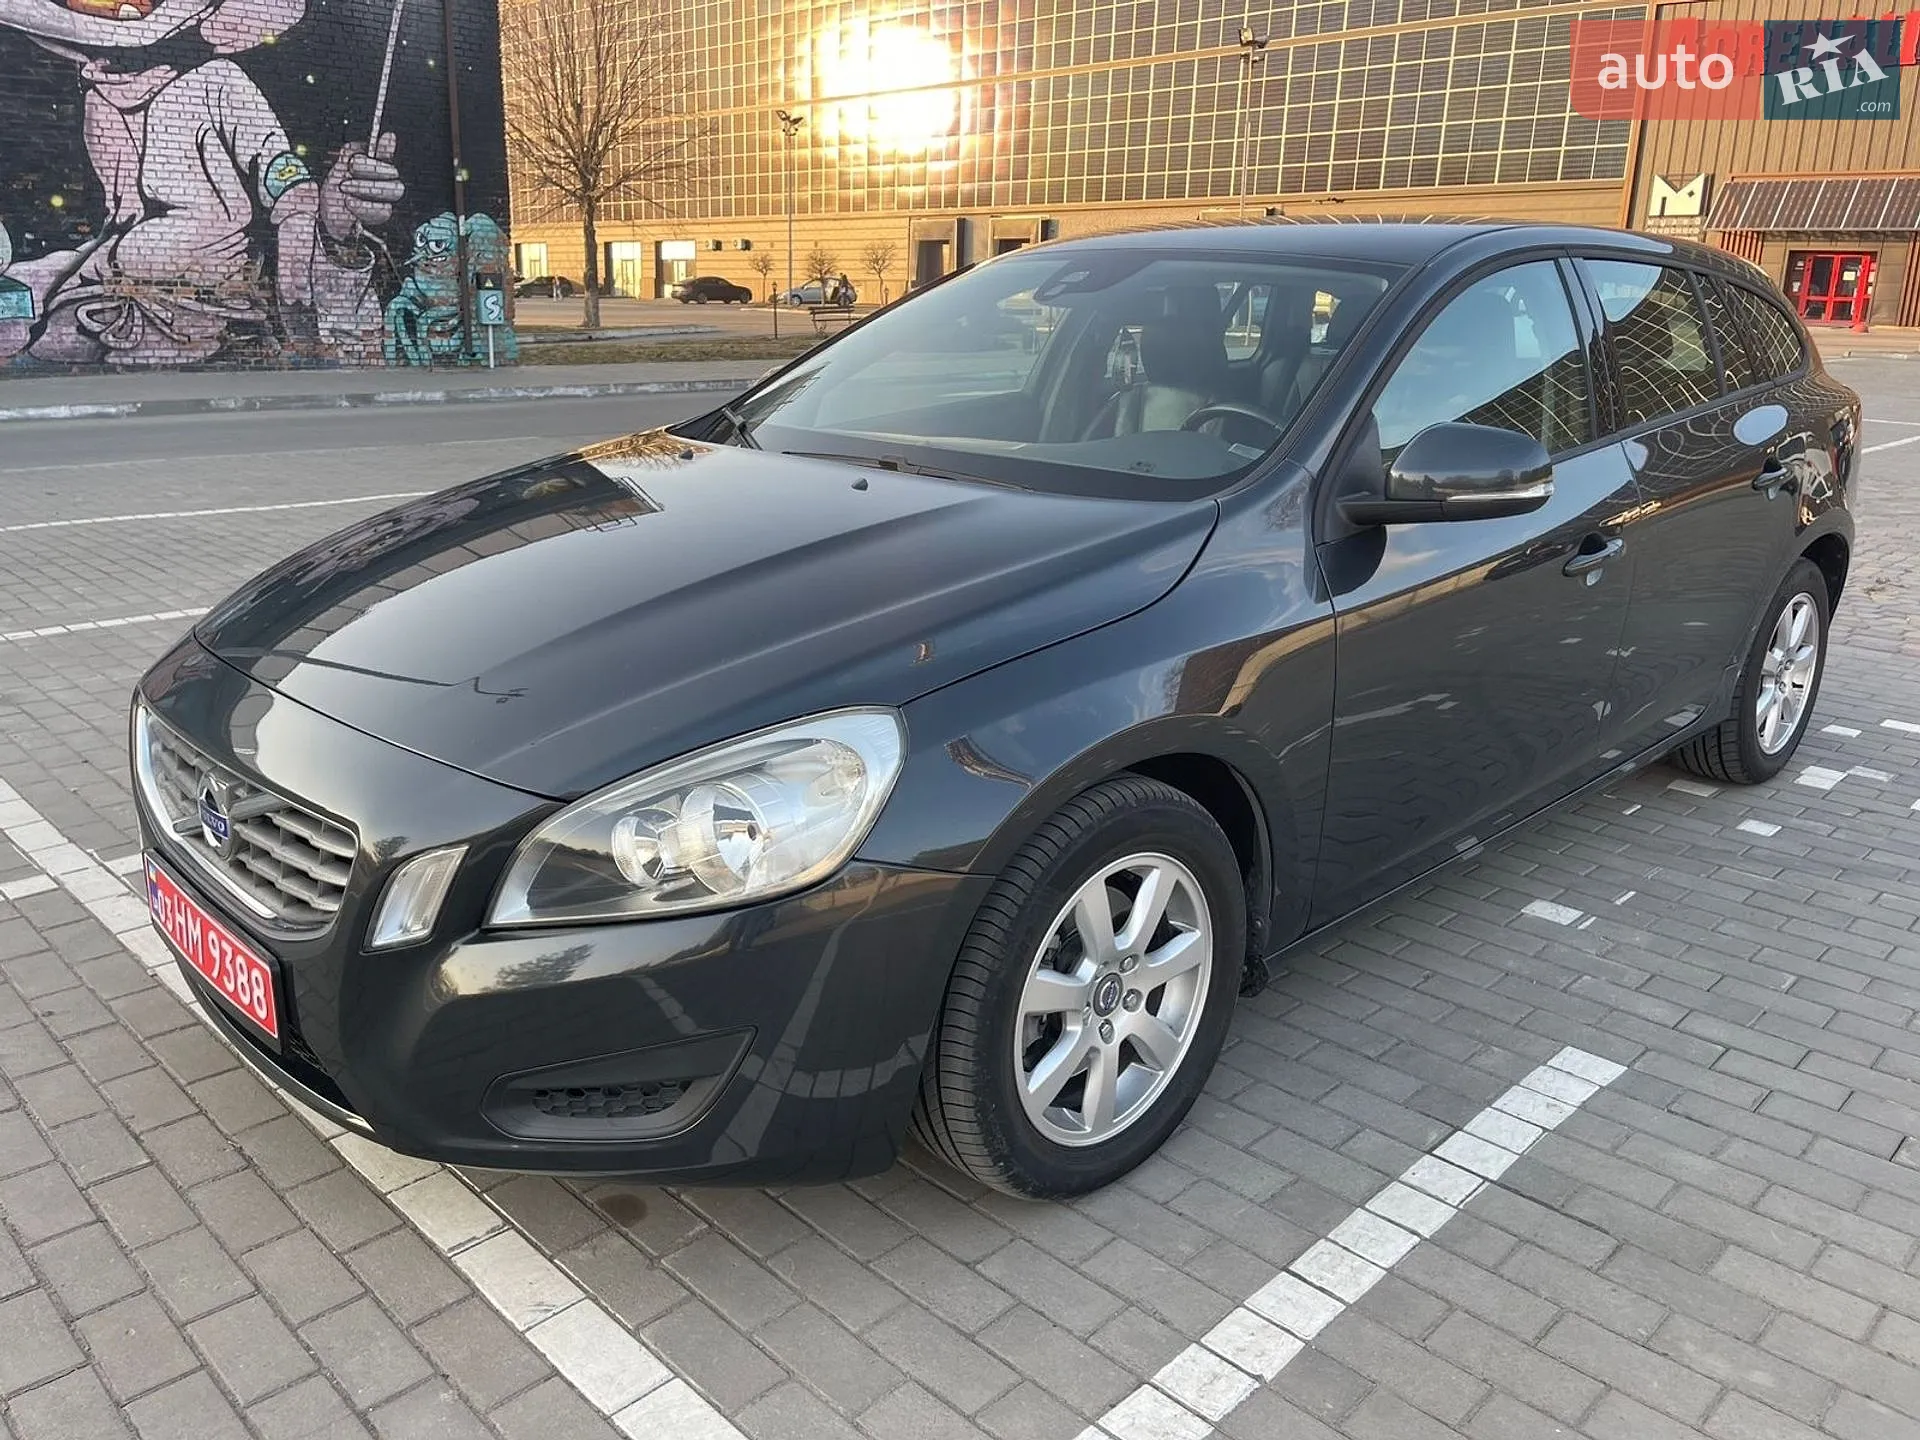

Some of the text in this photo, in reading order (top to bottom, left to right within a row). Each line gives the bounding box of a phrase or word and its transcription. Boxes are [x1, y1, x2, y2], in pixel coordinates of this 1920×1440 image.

[157, 889, 268, 1021] 03 HM 9388
